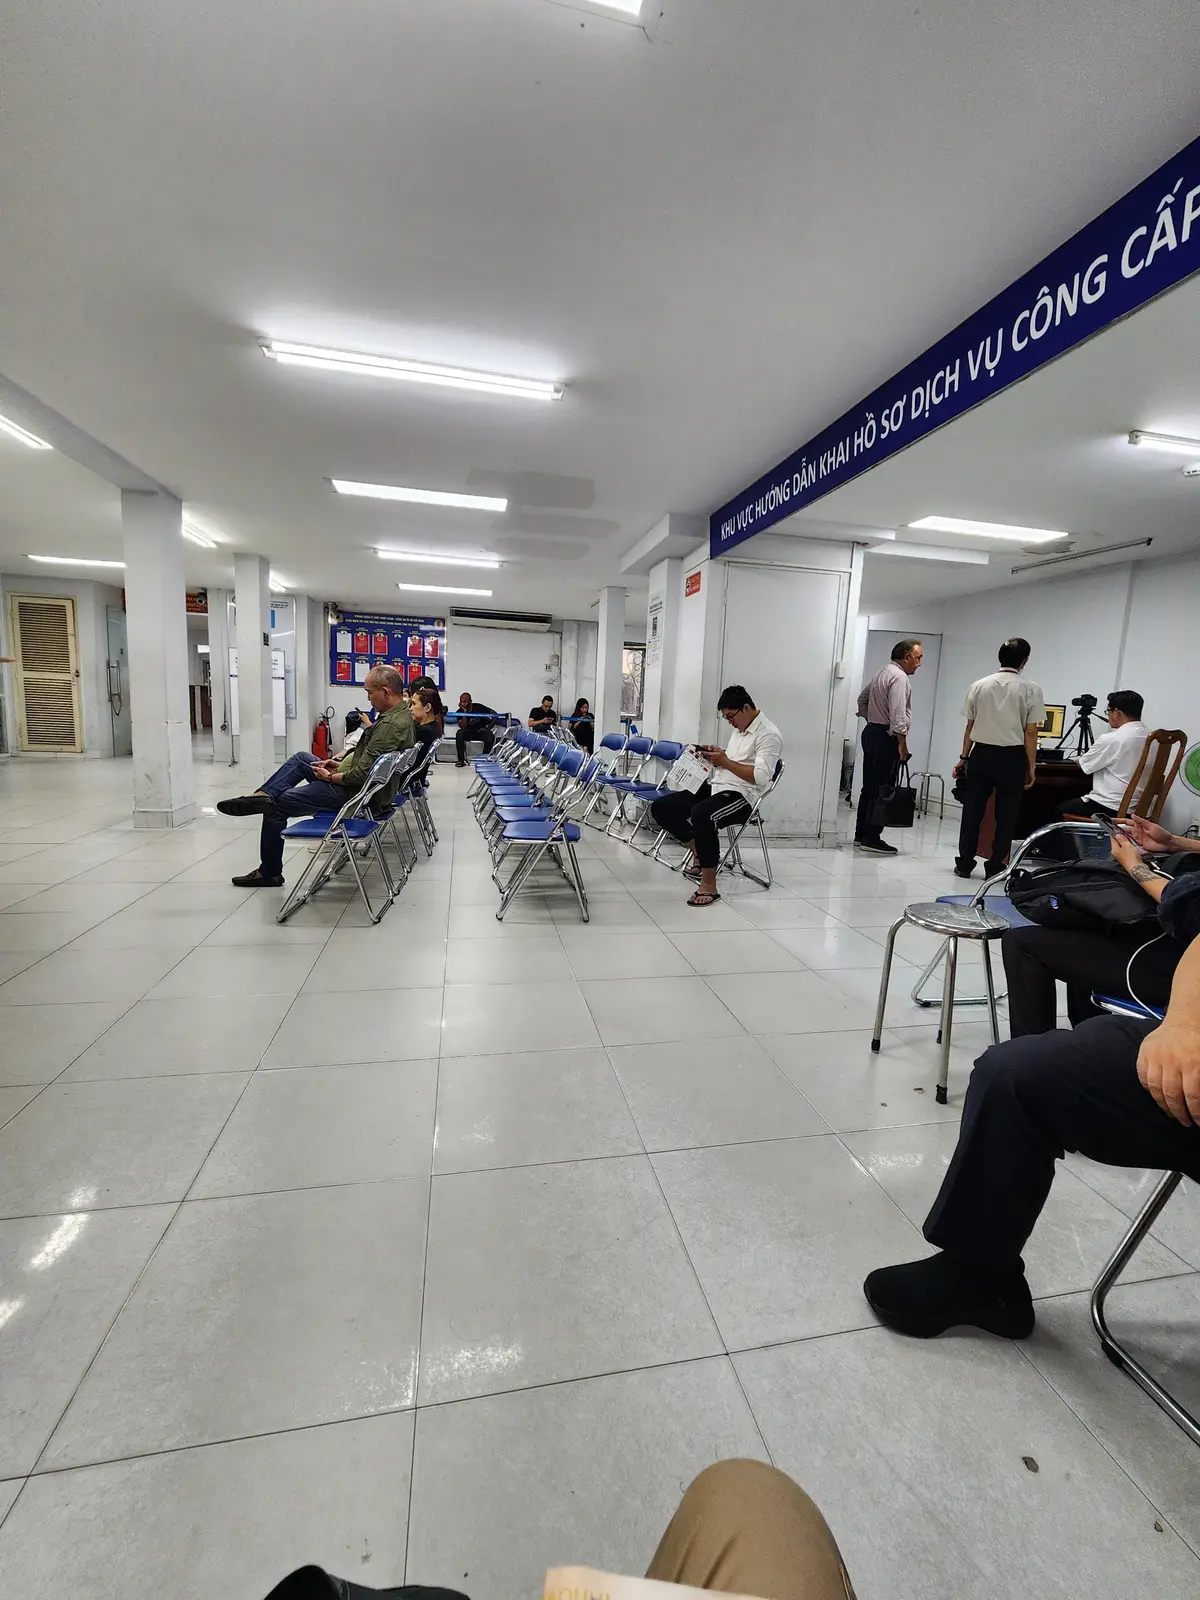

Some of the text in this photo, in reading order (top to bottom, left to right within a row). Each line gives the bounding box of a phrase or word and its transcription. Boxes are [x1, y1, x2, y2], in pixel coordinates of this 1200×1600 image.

[721, 517, 735, 541] KHU
[737, 504, 754, 531] VỰC
[755, 479, 791, 519] HƯỚNG
[793, 456, 817, 496] DẪN
[819, 436, 850, 479] KHAI
[853, 412, 877, 457] HỒ
[880, 394, 907, 440] SƠ
[911, 358, 960, 419] DỊCH
[967, 327, 1004, 382] VỤ
[1011, 253, 1109, 352] CÔNG
